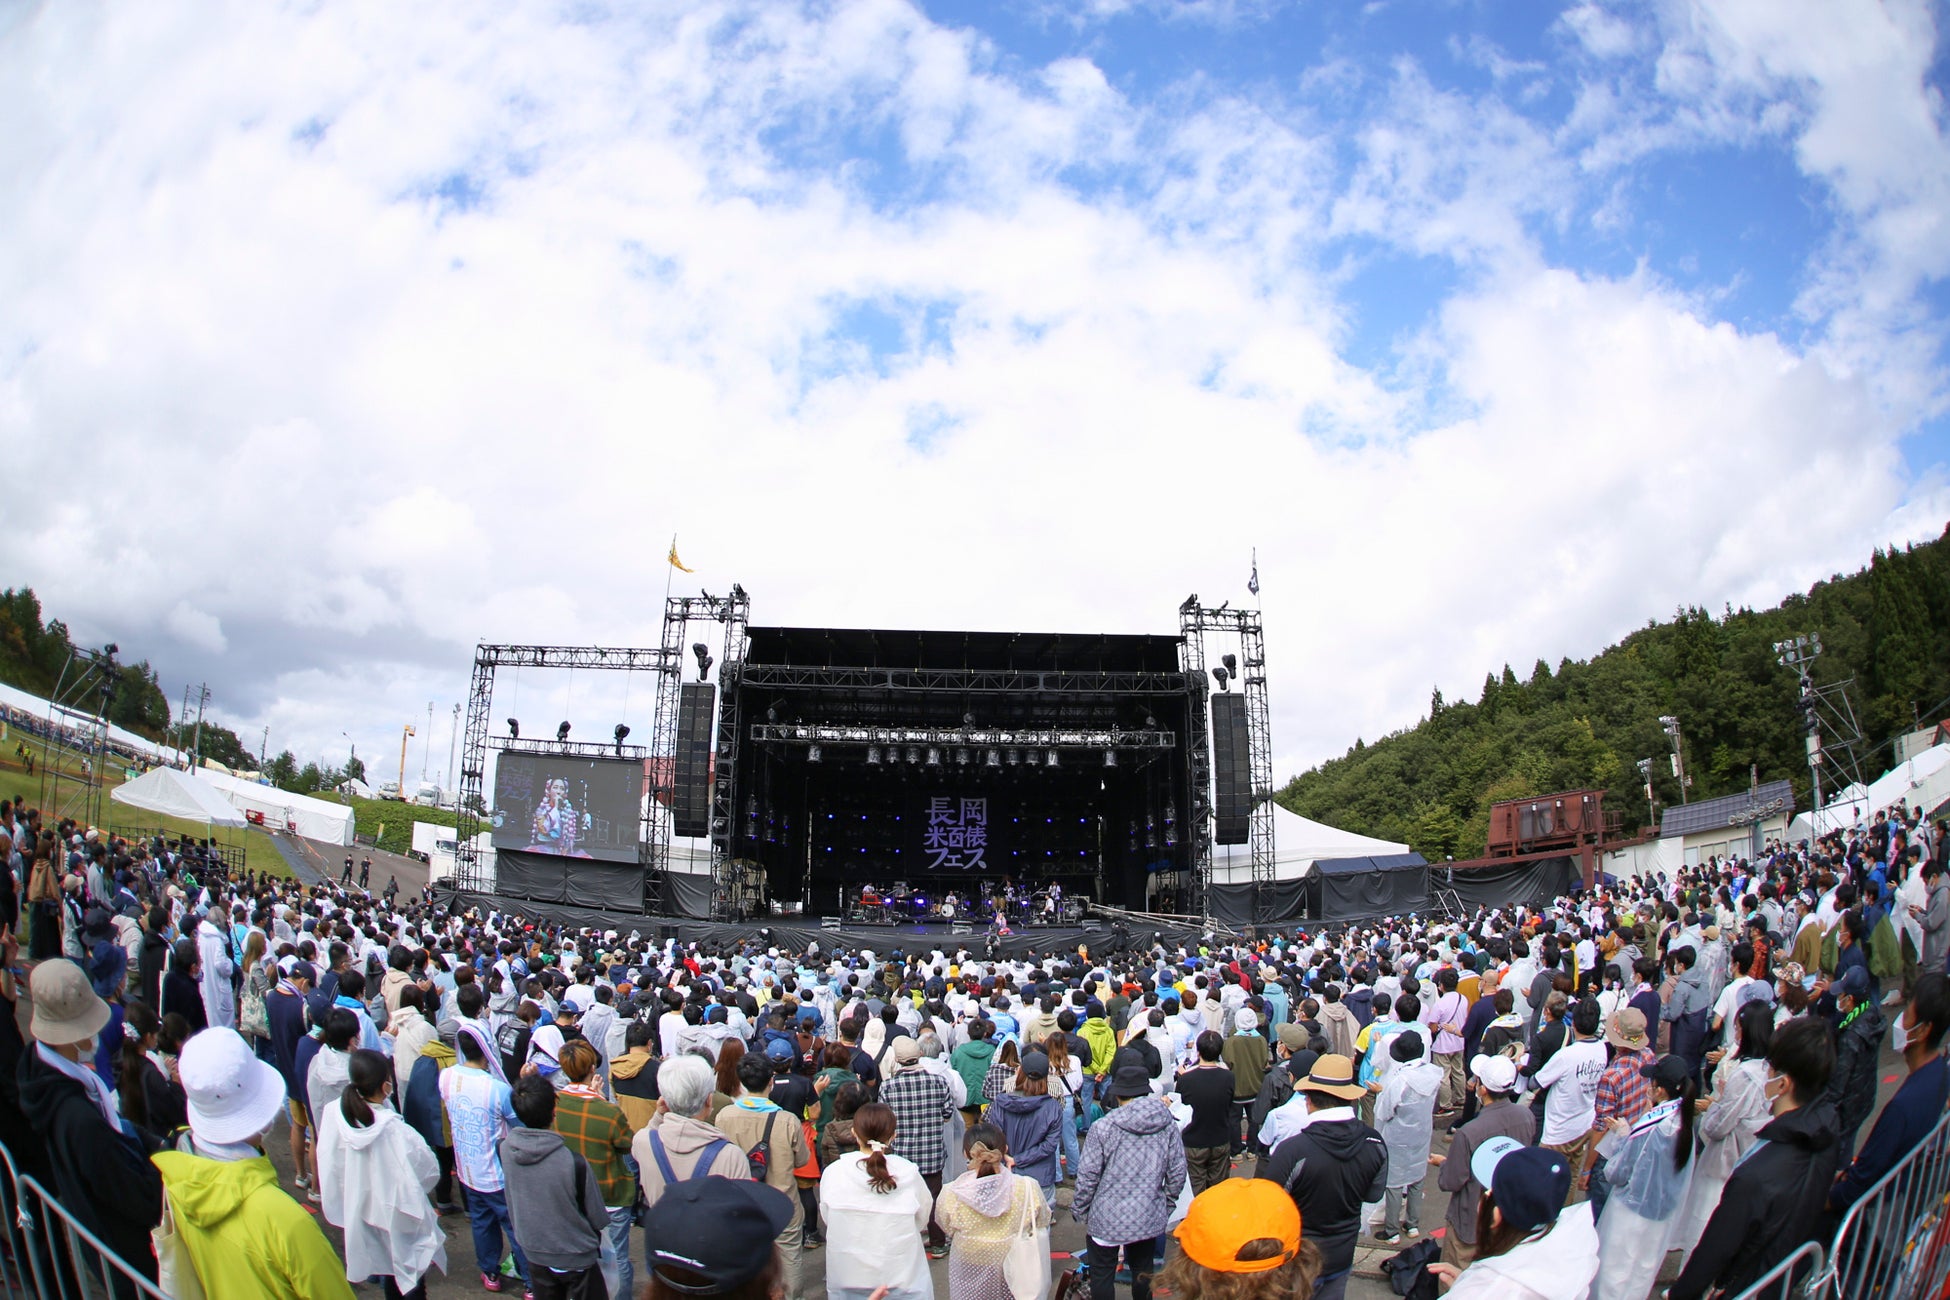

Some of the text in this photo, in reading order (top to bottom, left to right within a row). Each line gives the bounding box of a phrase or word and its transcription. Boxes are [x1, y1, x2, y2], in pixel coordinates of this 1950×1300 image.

[924, 796, 988, 826] 長岡
[923, 825, 988, 848] 米百俵
[924, 847, 988, 870] フェス
